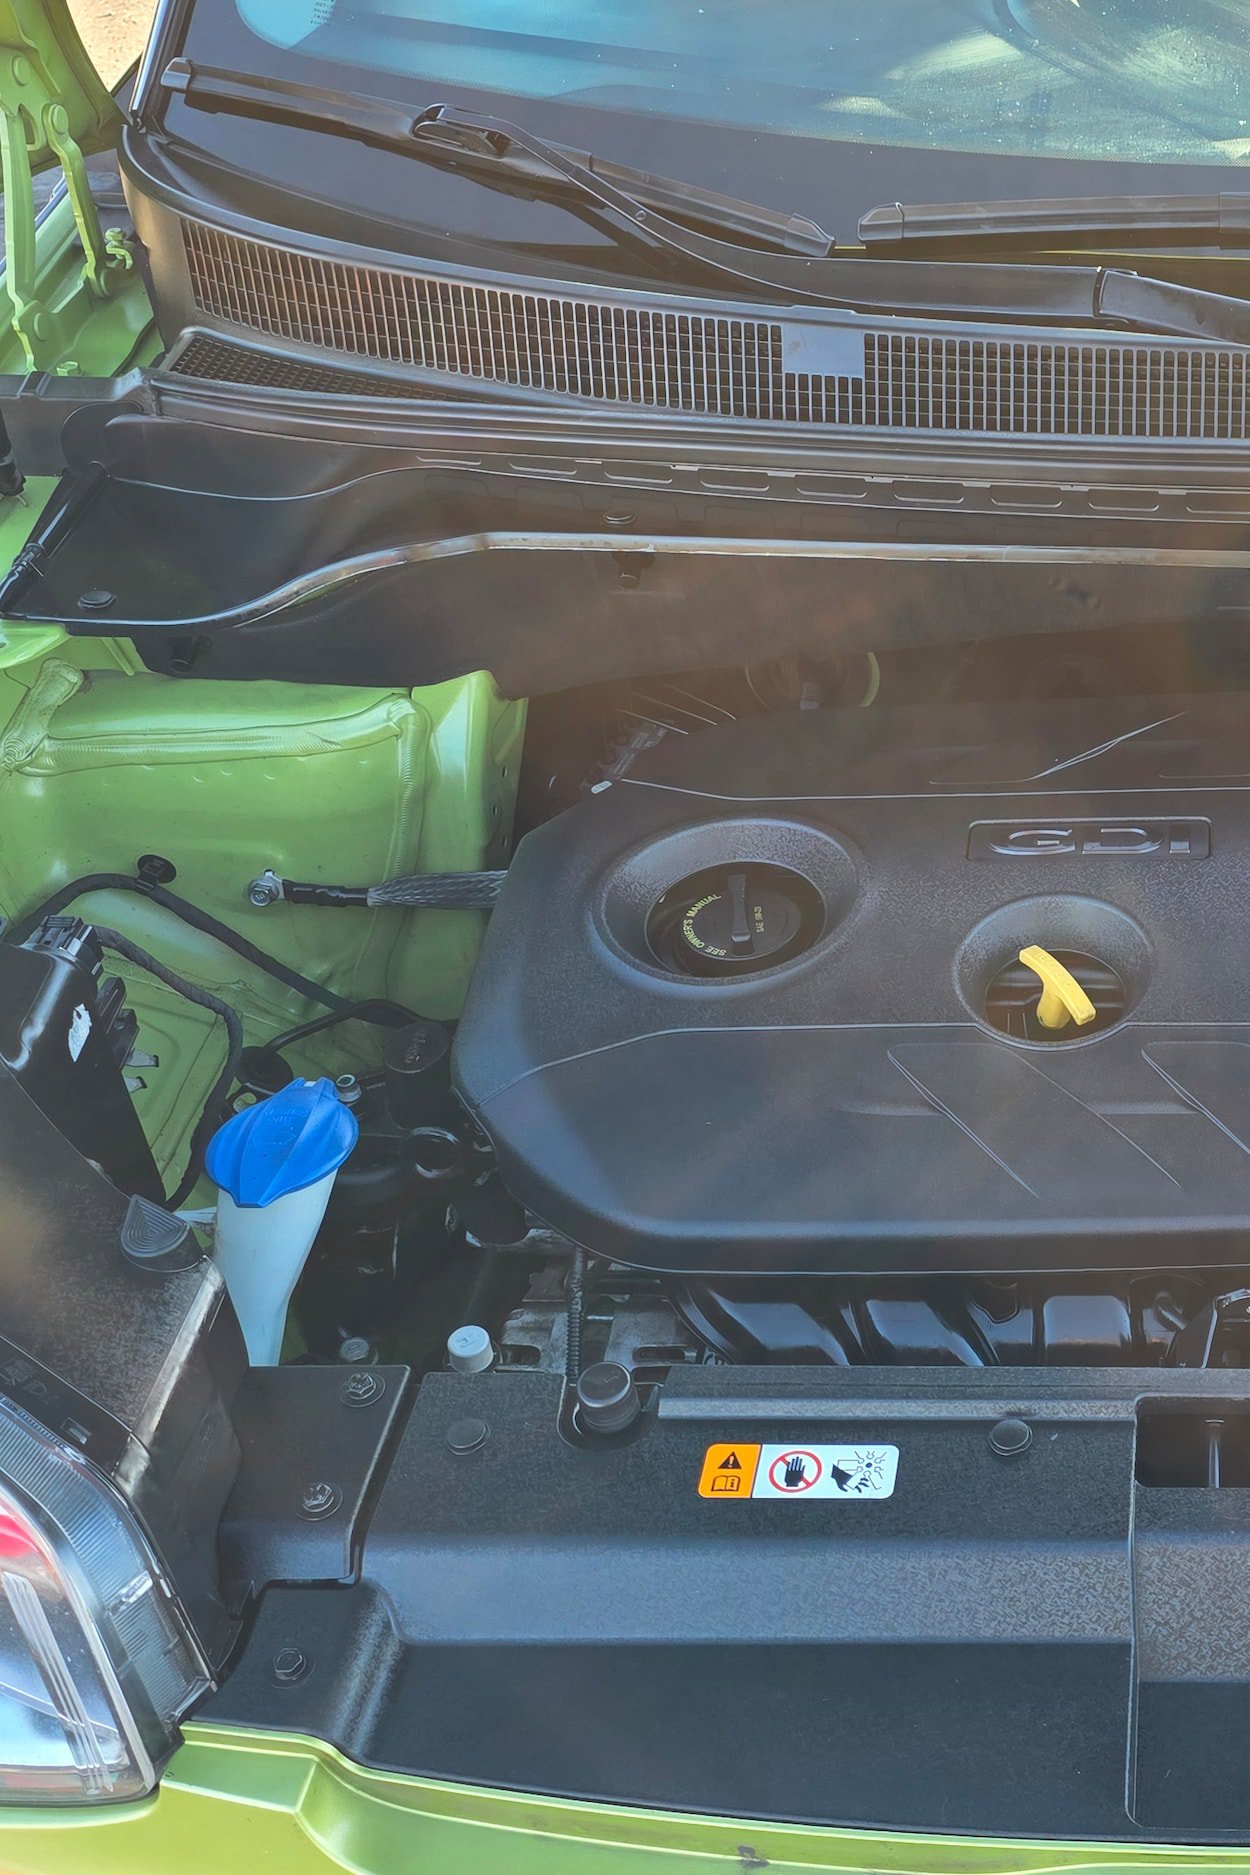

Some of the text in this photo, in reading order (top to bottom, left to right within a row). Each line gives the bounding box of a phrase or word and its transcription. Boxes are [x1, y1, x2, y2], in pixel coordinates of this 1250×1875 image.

[683, 893, 727, 956] SEE OWNER'S MANUAL
